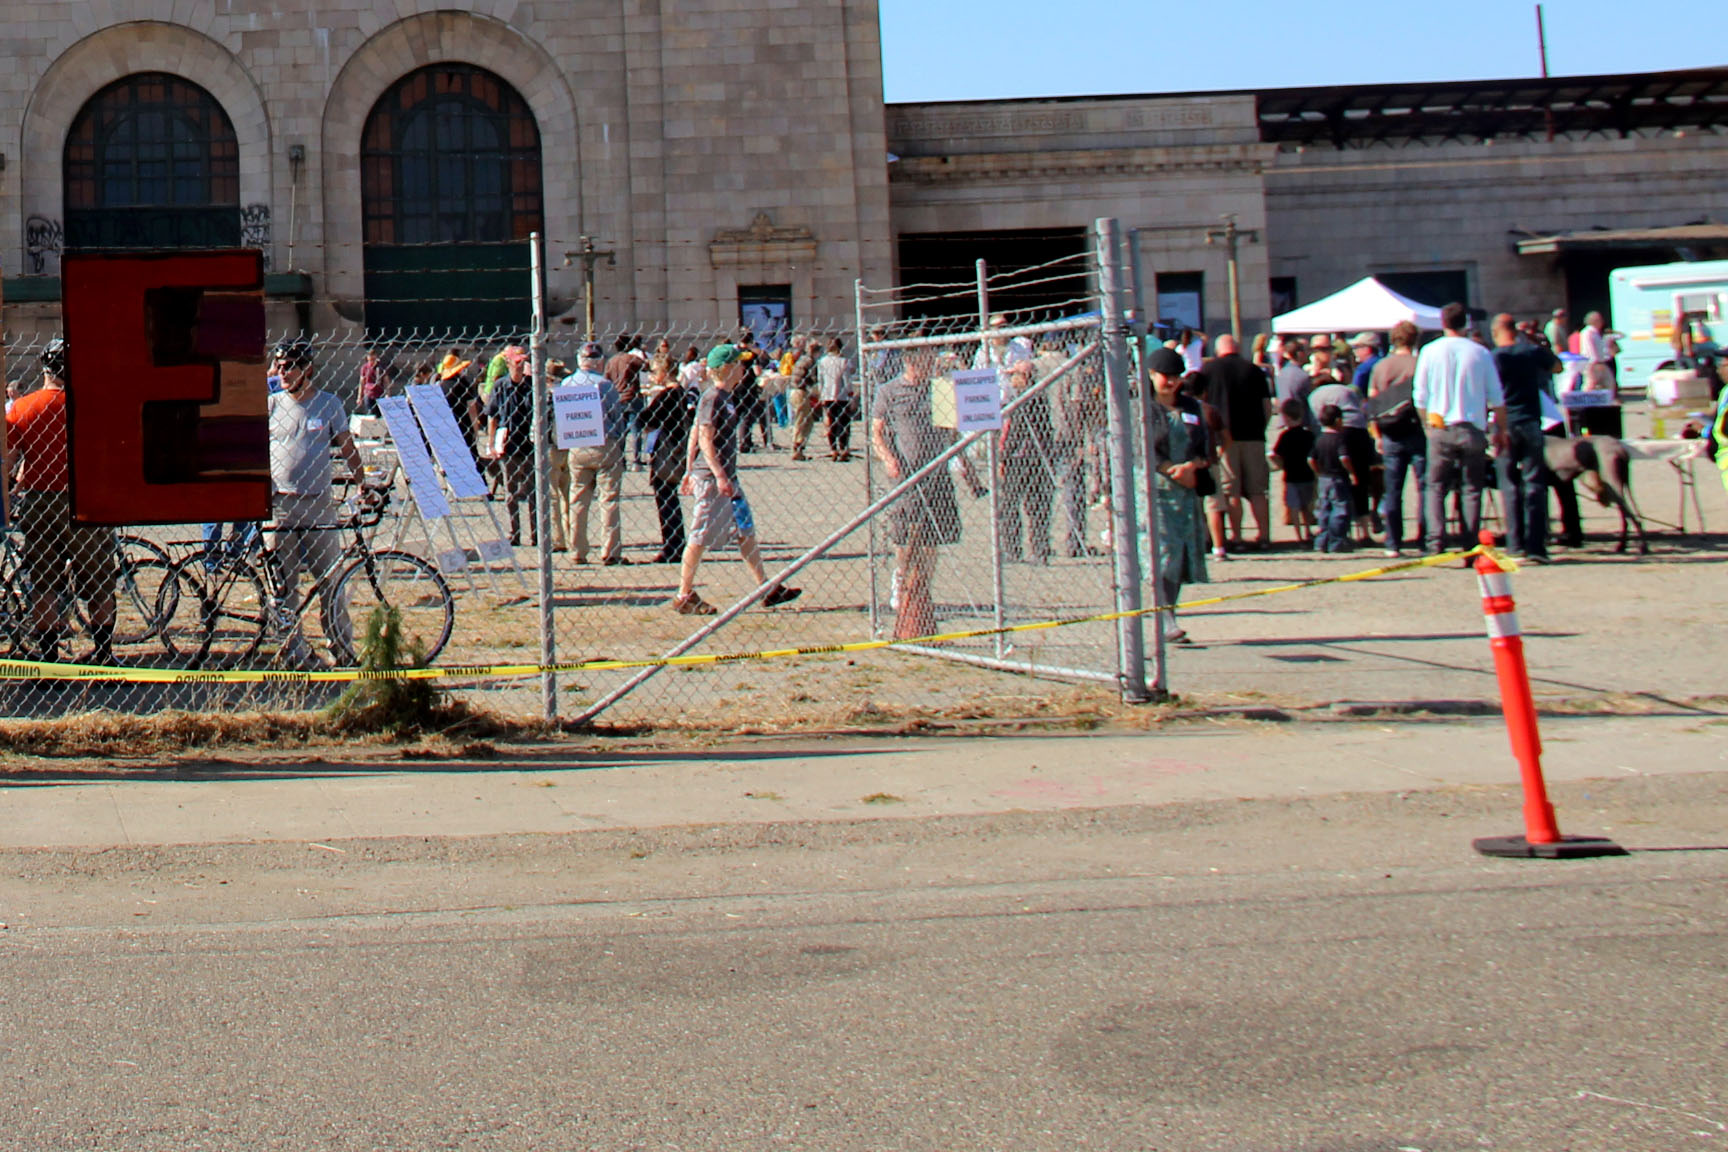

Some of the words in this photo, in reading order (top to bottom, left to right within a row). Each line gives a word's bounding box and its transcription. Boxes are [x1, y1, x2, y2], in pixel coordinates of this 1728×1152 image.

[555, 391, 598, 403] HANDICAPPED
[964, 394, 991, 404] PARKING
[565, 410, 592, 421] PARKING
